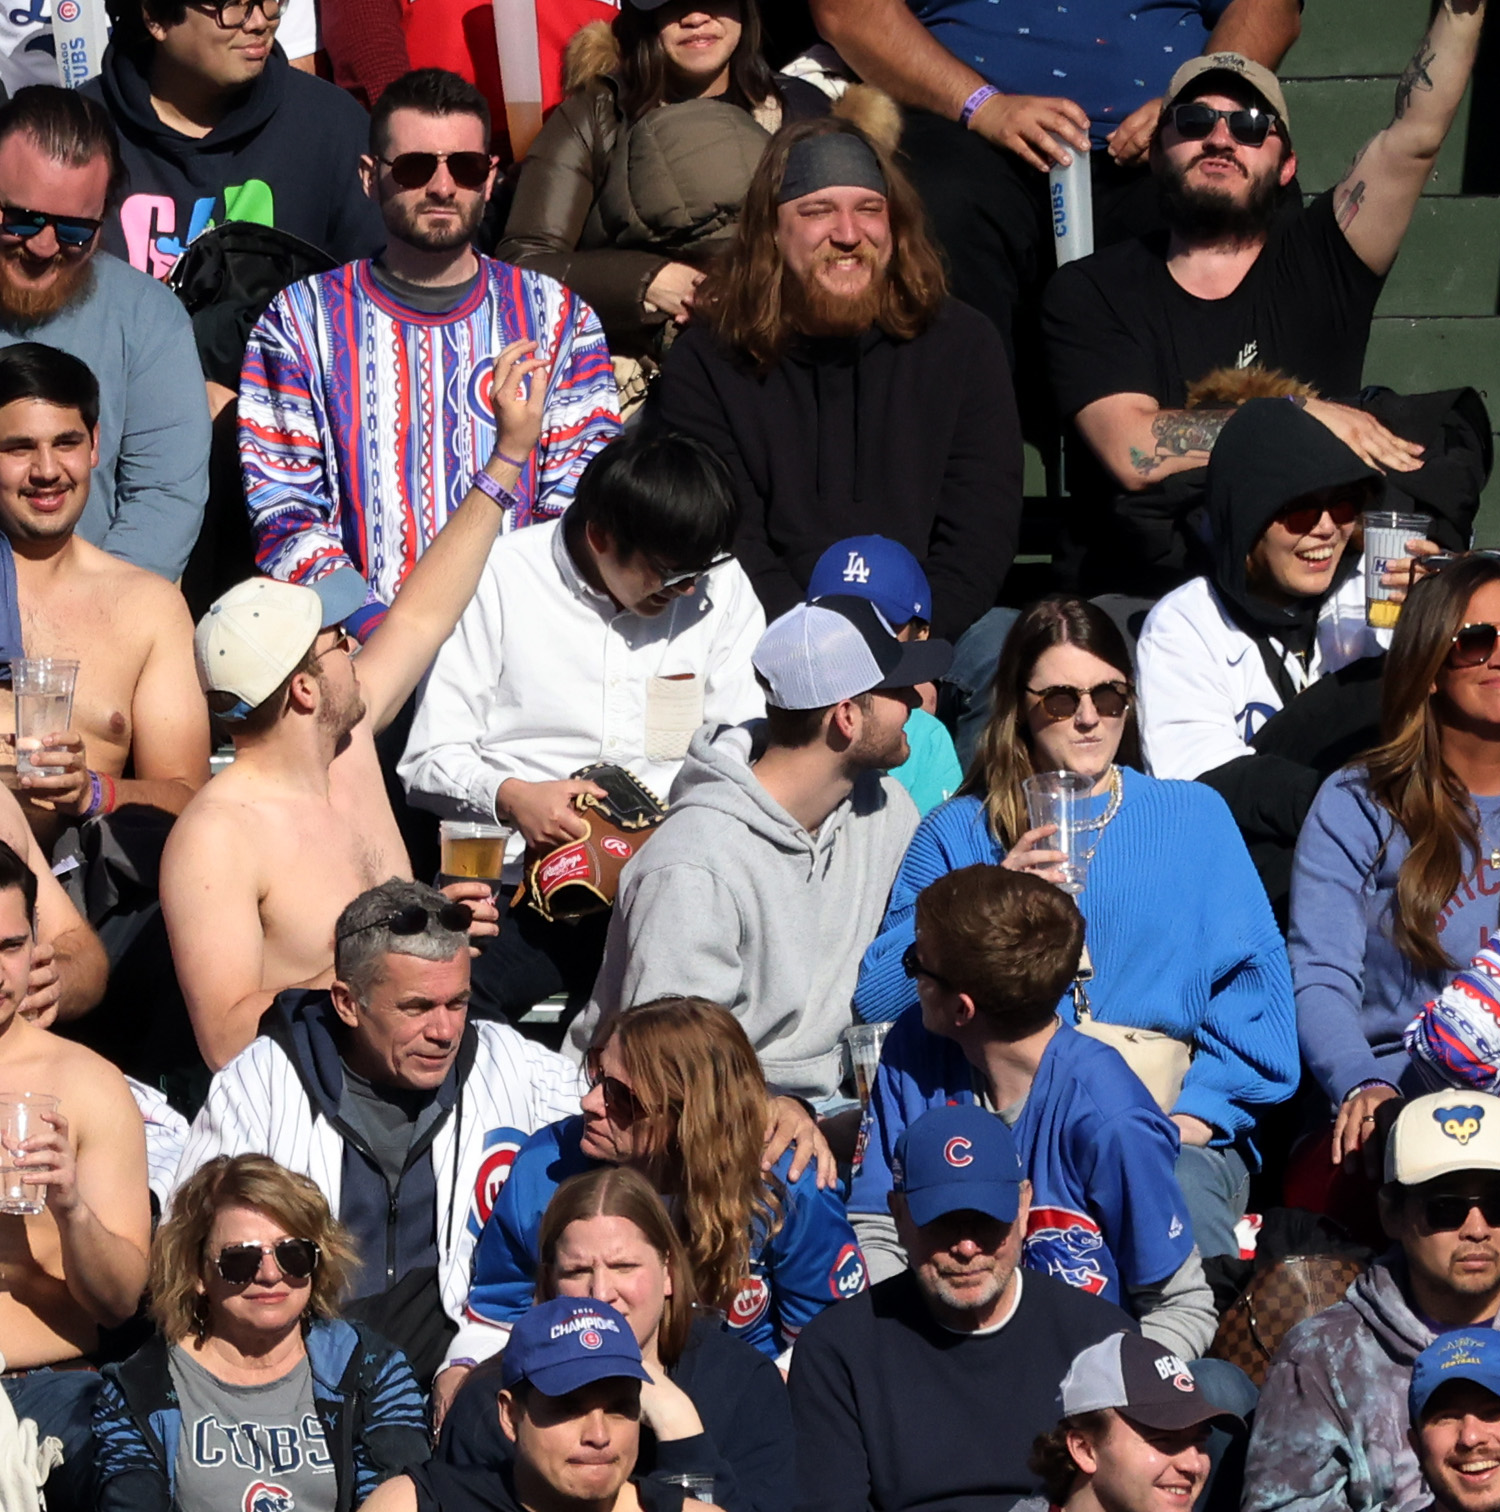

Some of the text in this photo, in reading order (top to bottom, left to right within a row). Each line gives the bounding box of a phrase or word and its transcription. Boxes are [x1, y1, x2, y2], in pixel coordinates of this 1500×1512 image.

[1054, 182, 1070, 240] CUBS
[842, 551, 871, 583] LA
[542, 852, 583, 881] Rawlings
[943, 1136, 974, 1168] C
[192, 1414, 334, 1477] CUBS
